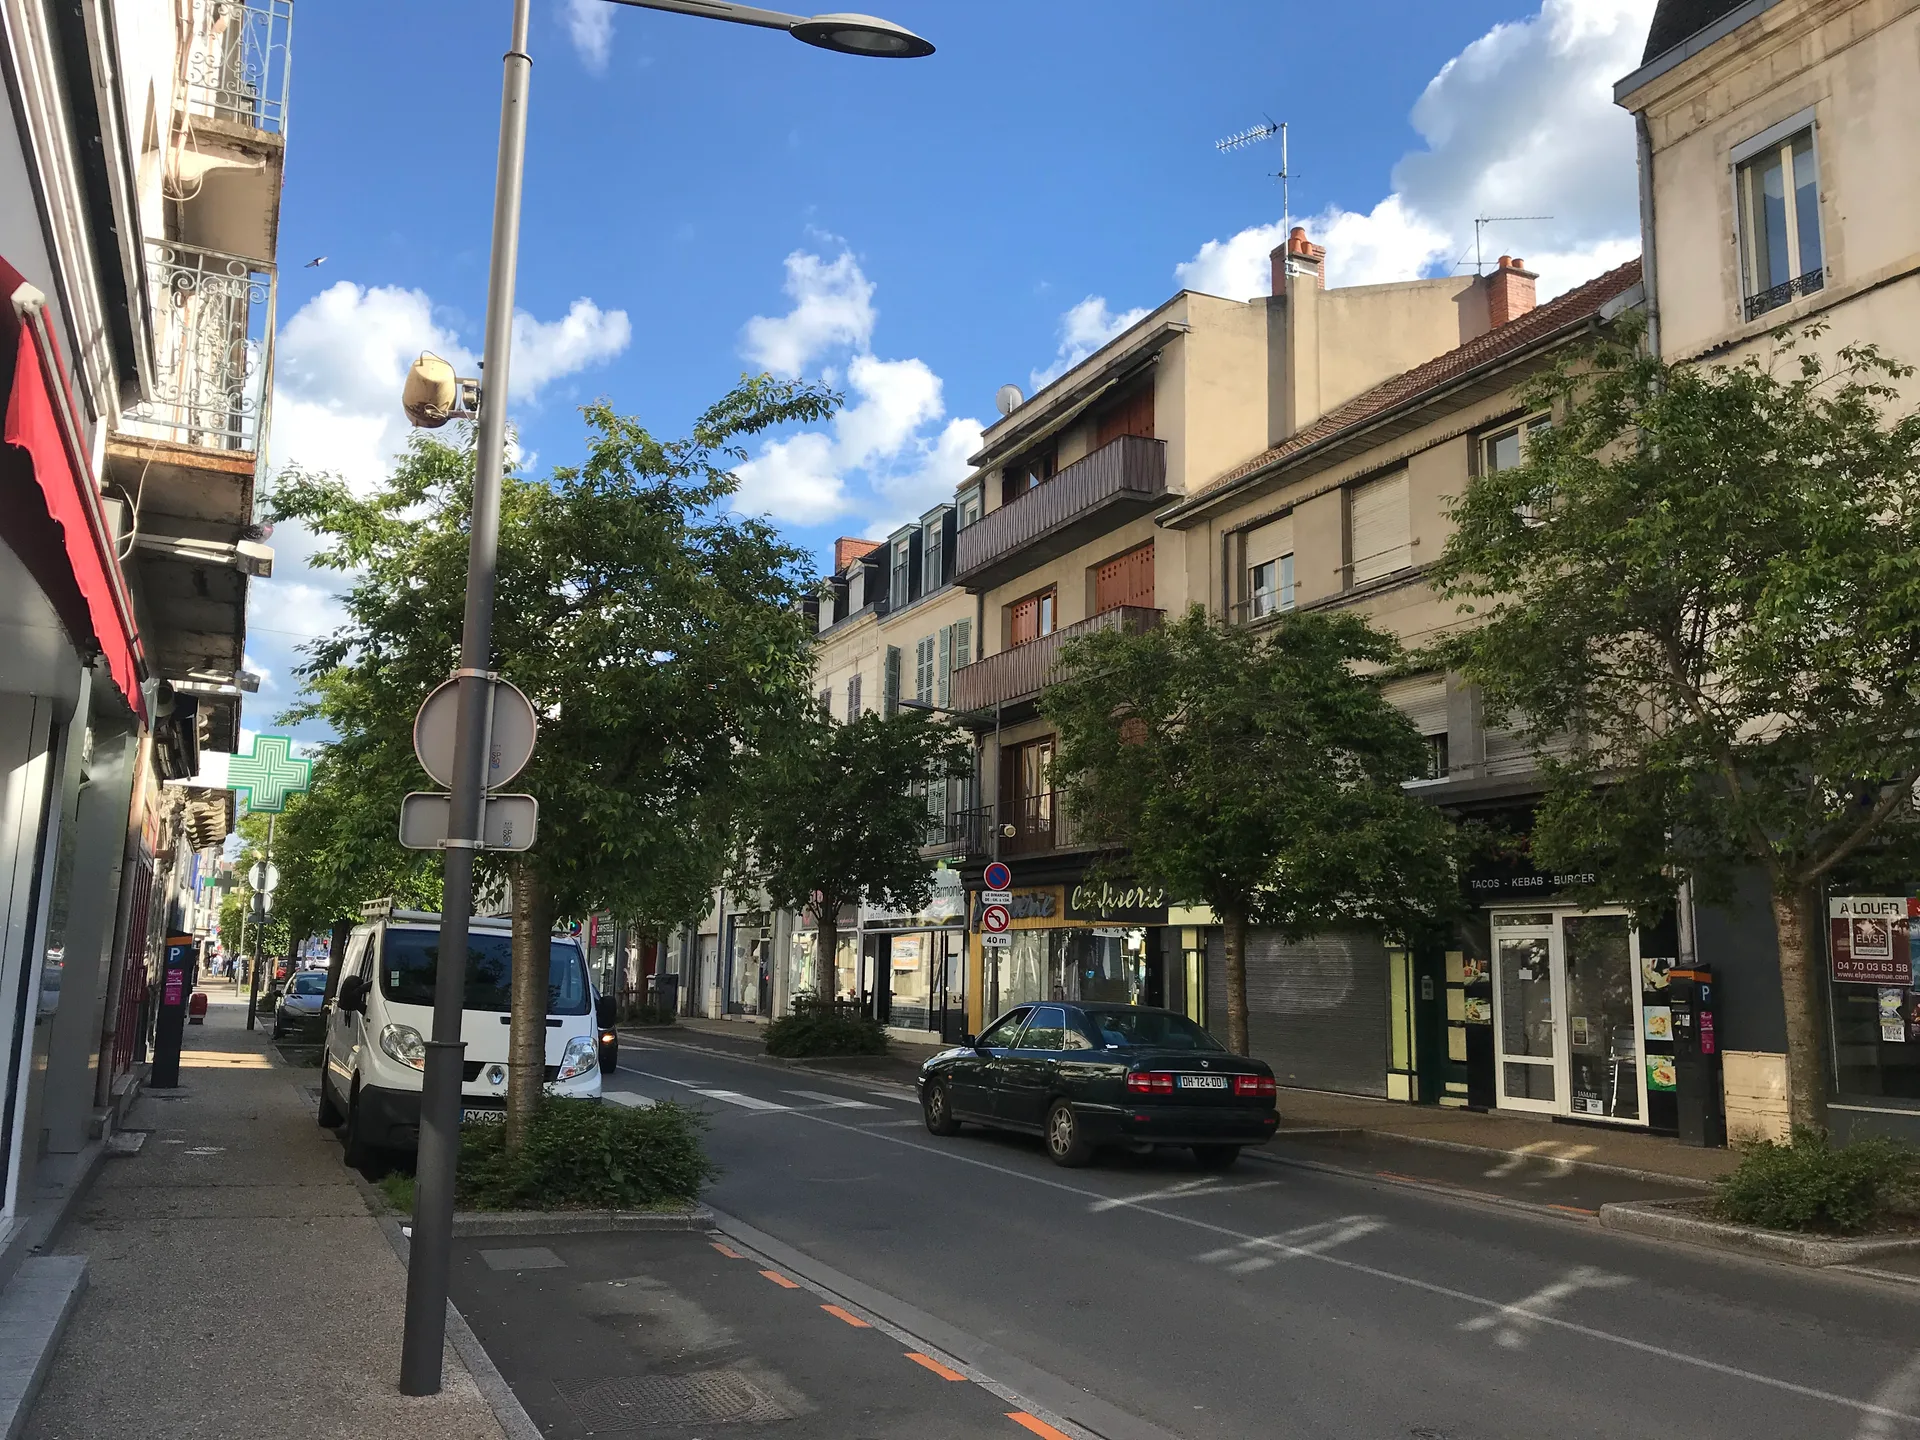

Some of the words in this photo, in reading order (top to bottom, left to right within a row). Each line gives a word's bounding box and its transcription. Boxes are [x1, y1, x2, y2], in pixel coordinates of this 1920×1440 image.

[1471, 879, 1500, 889] TACOS
[1512, 877, 1543, 887] KEBAB
[1853, 903, 1900, 914] LOUER
[986, 936, 998, 944] 40
[170, 947, 181, 961] P
[1837, 961, 1849, 970] 04
[1852, 962, 1864, 971] 70
[1866, 962, 1879, 971] 03
[1881, 963, 1893, 972] 63
[1896, 963, 1909, 973] 58
[1702, 985, 1710, 1001] P
